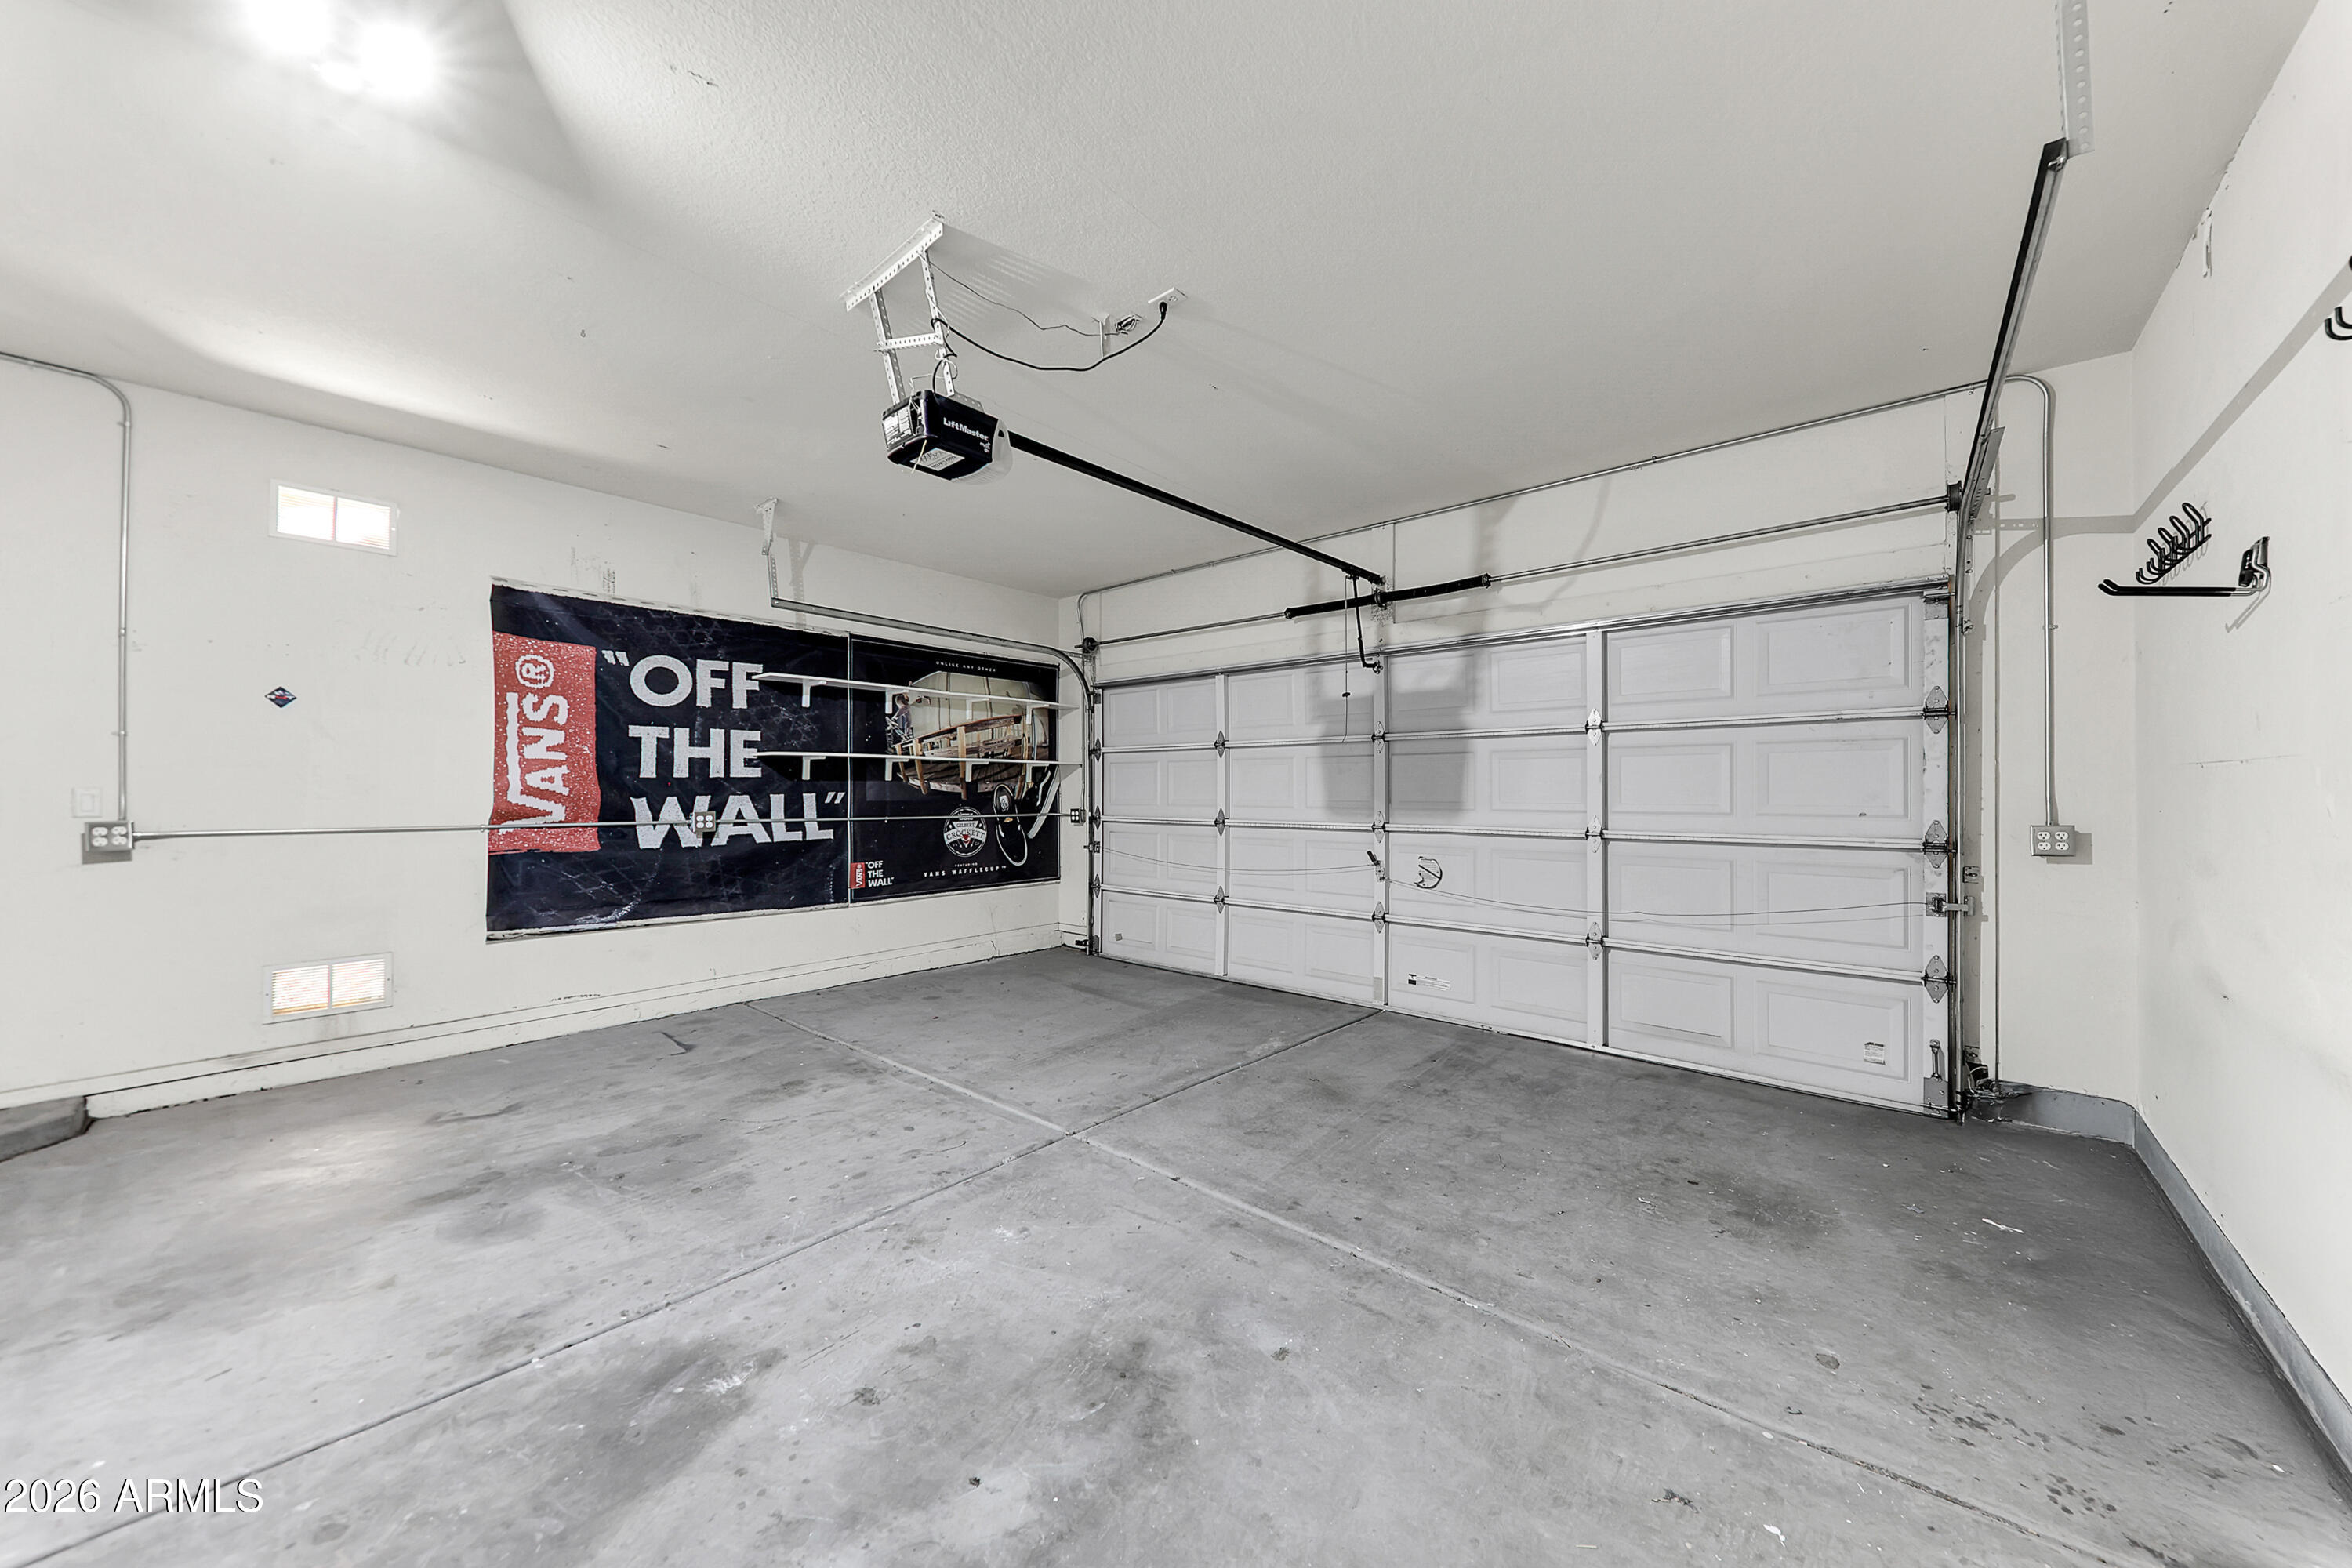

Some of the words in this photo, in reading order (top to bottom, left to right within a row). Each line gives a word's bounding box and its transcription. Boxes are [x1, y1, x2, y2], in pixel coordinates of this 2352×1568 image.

[943, 416, 989, 441] LiftMaster
[628, 724, 762, 779] THE
[867, 869, 884, 878] THE
